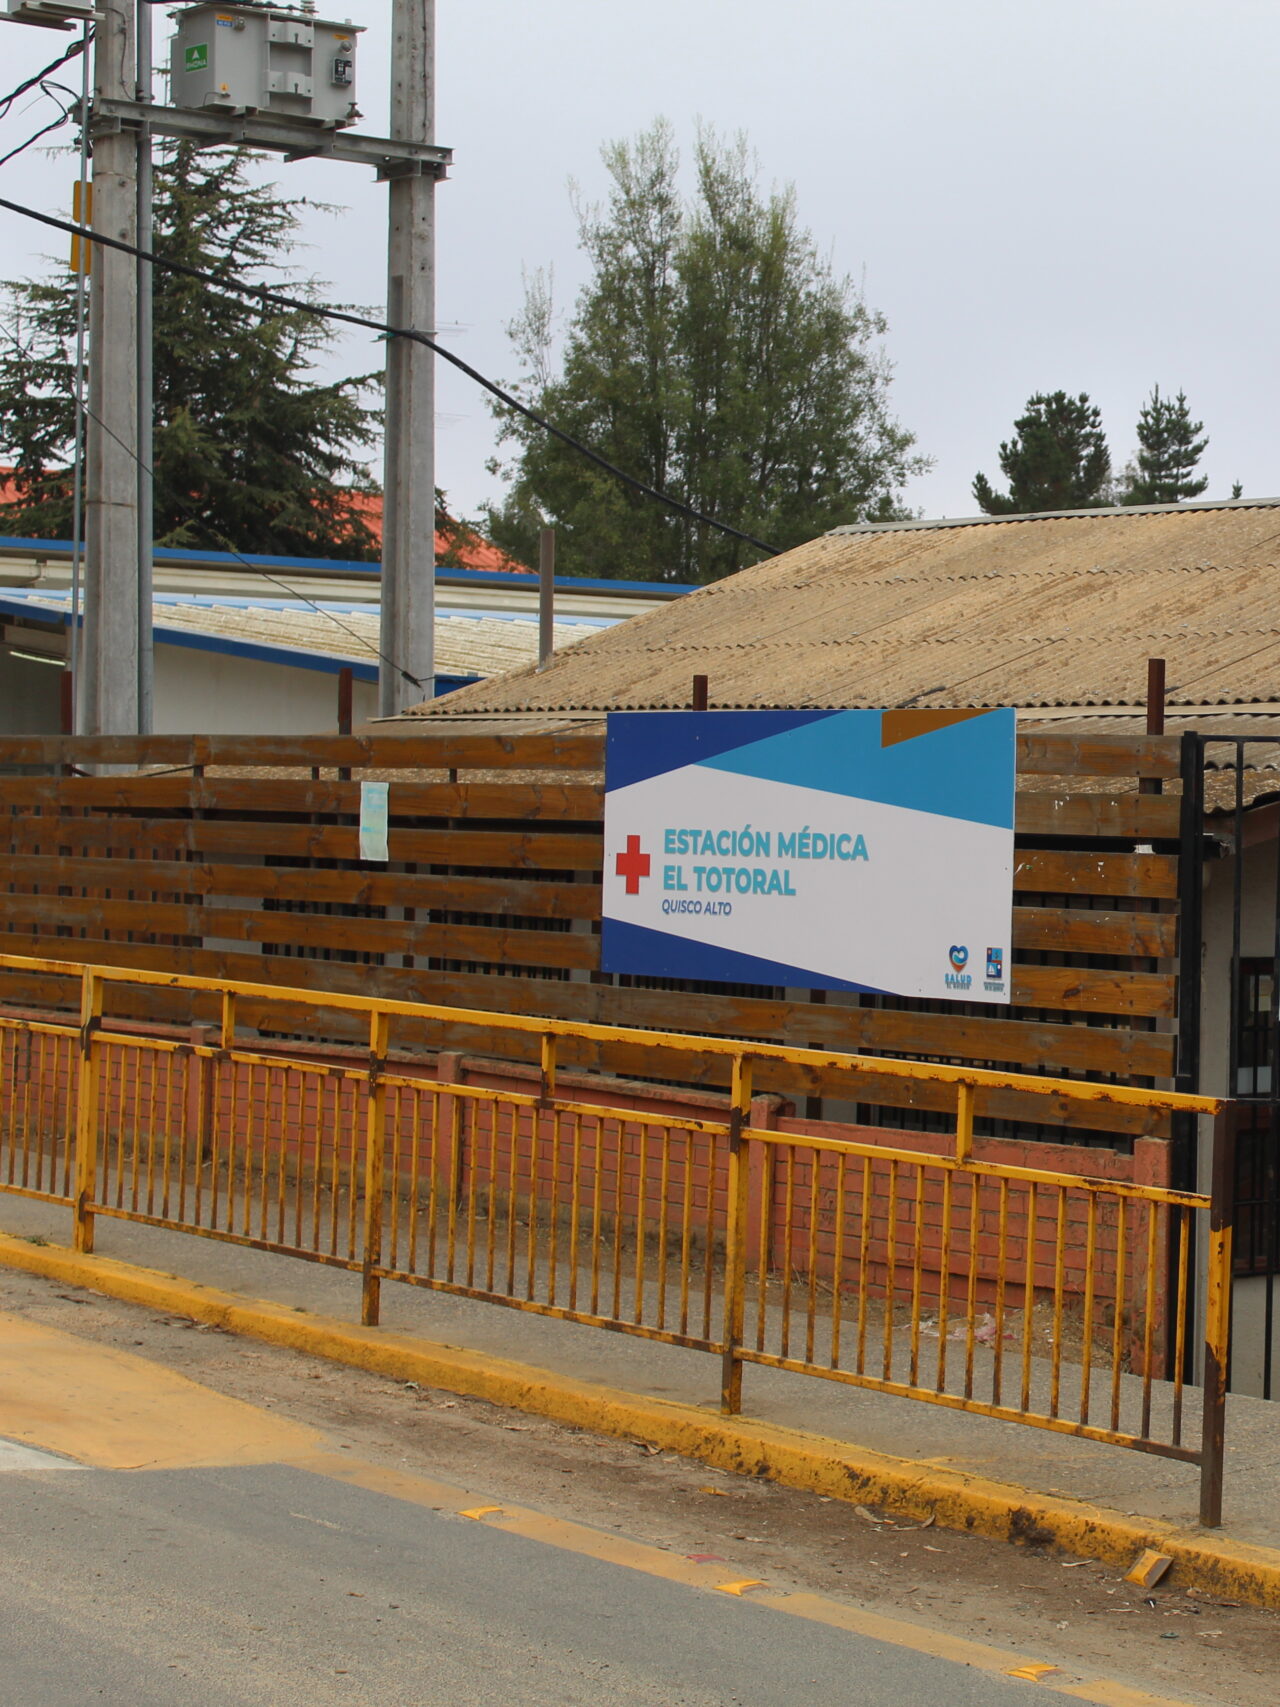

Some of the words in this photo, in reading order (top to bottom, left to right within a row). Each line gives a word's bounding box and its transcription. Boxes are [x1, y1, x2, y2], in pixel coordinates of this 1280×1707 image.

[664, 824, 770, 857] ESTACIÓN
[777, 825, 869, 861] MÉDICA
[663, 865, 688, 891] EL
[693, 866, 796, 896] TOTORAL
[662, 899, 702, 915] QUISCO
[703, 901, 732, 916] ALTO
[945, 973, 972, 984] SALUD
